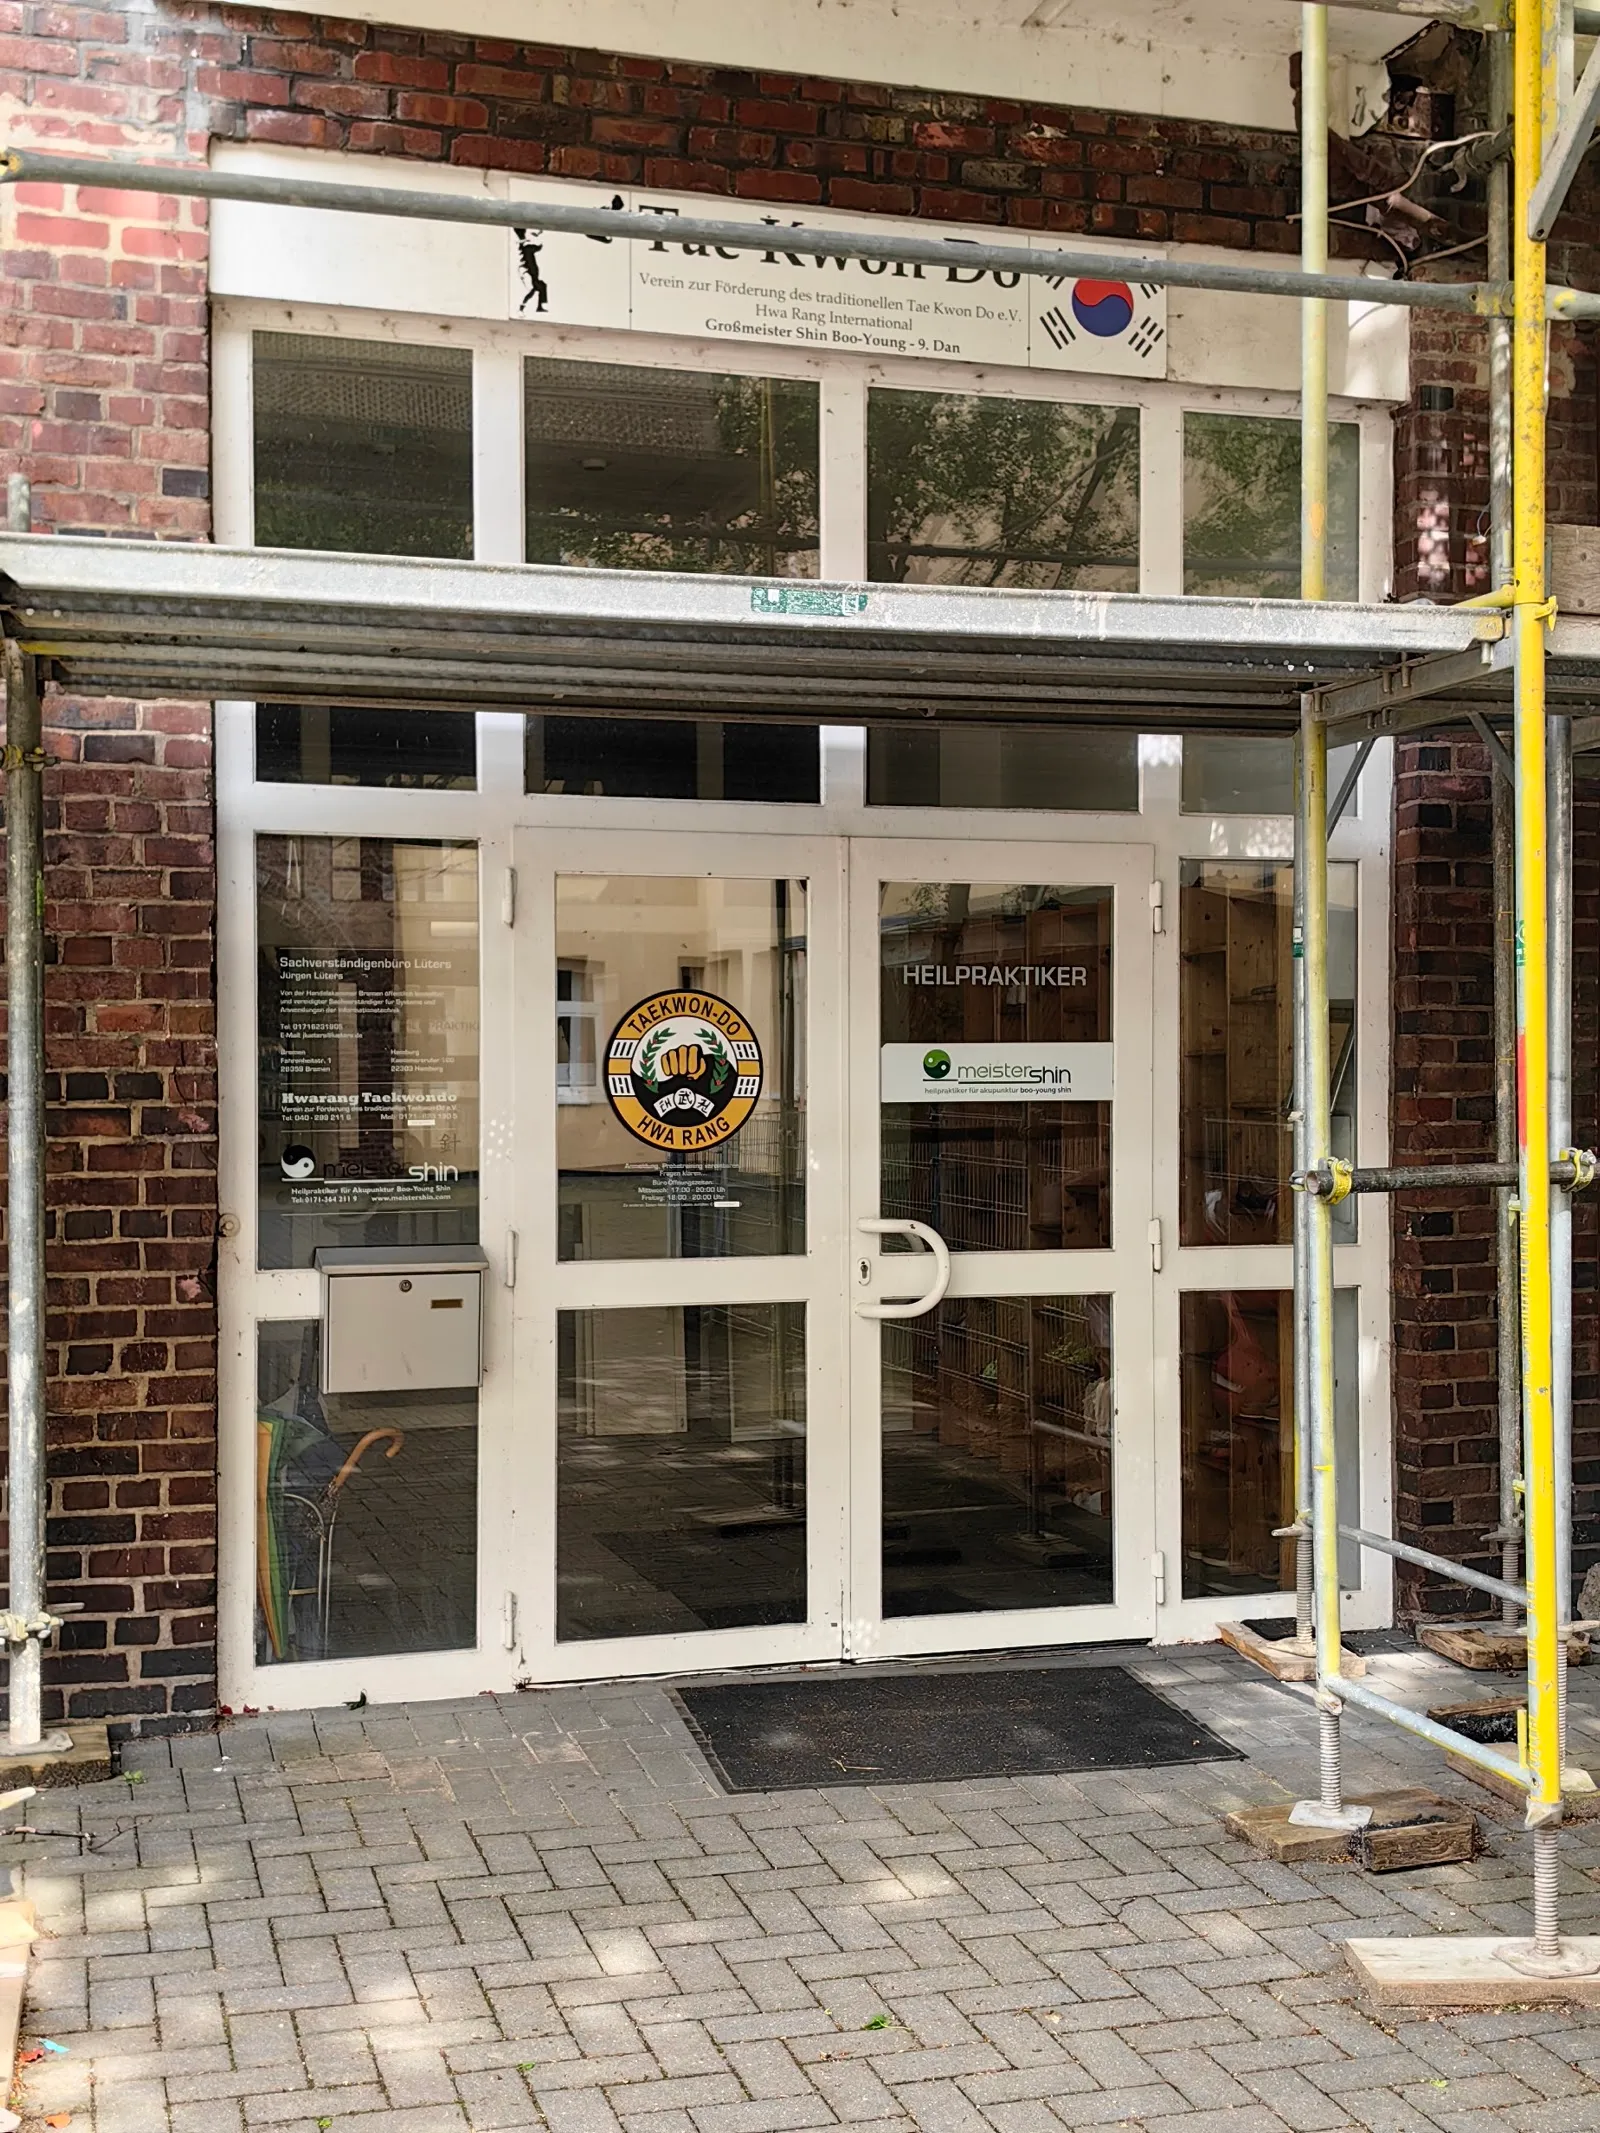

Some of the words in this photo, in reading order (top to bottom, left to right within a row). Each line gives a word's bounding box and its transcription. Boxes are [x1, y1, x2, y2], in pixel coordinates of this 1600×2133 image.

[639, 272, 684, 290] Verein
[688, 280, 711, 292] zur
[715, 280, 786, 302] Förderung
[790, 287, 812, 302] des
[816, 291, 903, 311] traditionellen
[906, 299, 930, 314] Tae
[934, 302, 972, 318] Kwon
[976, 306, 994, 320] Do
[997, 309, 1022, 322] e.V.
[755, 304, 788, 319] Hwa
[792, 307, 826, 326] Rang
[829, 310, 913, 331] International
[705, 318, 792, 338] Großmeister
[796, 327, 828, 342] Shin
[832, 330, 907, 352] Boo-Young
[918, 339, 929, 351] 9.
[933, 340, 961, 353] Dan
[280, 957, 411, 971] Sachverständigenbüro
[414, 958, 452, 969] Lüters
[280, 971, 312, 982] Jürgen
[313, 971, 344, 980] Lüters
[903, 964, 1087, 987] HEILPRAKTIKER
[628, 997, 741, 1036] TAEKWON-DO
[281, 1092, 360, 1106] Hwarang
[361, 1092, 457, 1103] Taekwondo
[924, 1087, 967, 1095] heilpraktiker
[979, 1087, 1019, 1095] akupunktur
[1020, 1087, 1056, 1095] boo-young
[637, 1114, 674, 1145] HWA
[682, 1116, 731, 1146] RANG
[291, 1187, 338, 1196] Heilpraktiker
[352, 1186, 394, 1195] Akupunktur
[396, 1185, 434, 1193] Boo-Young
[371, 1194, 451, 1202] www.meistershin.com
